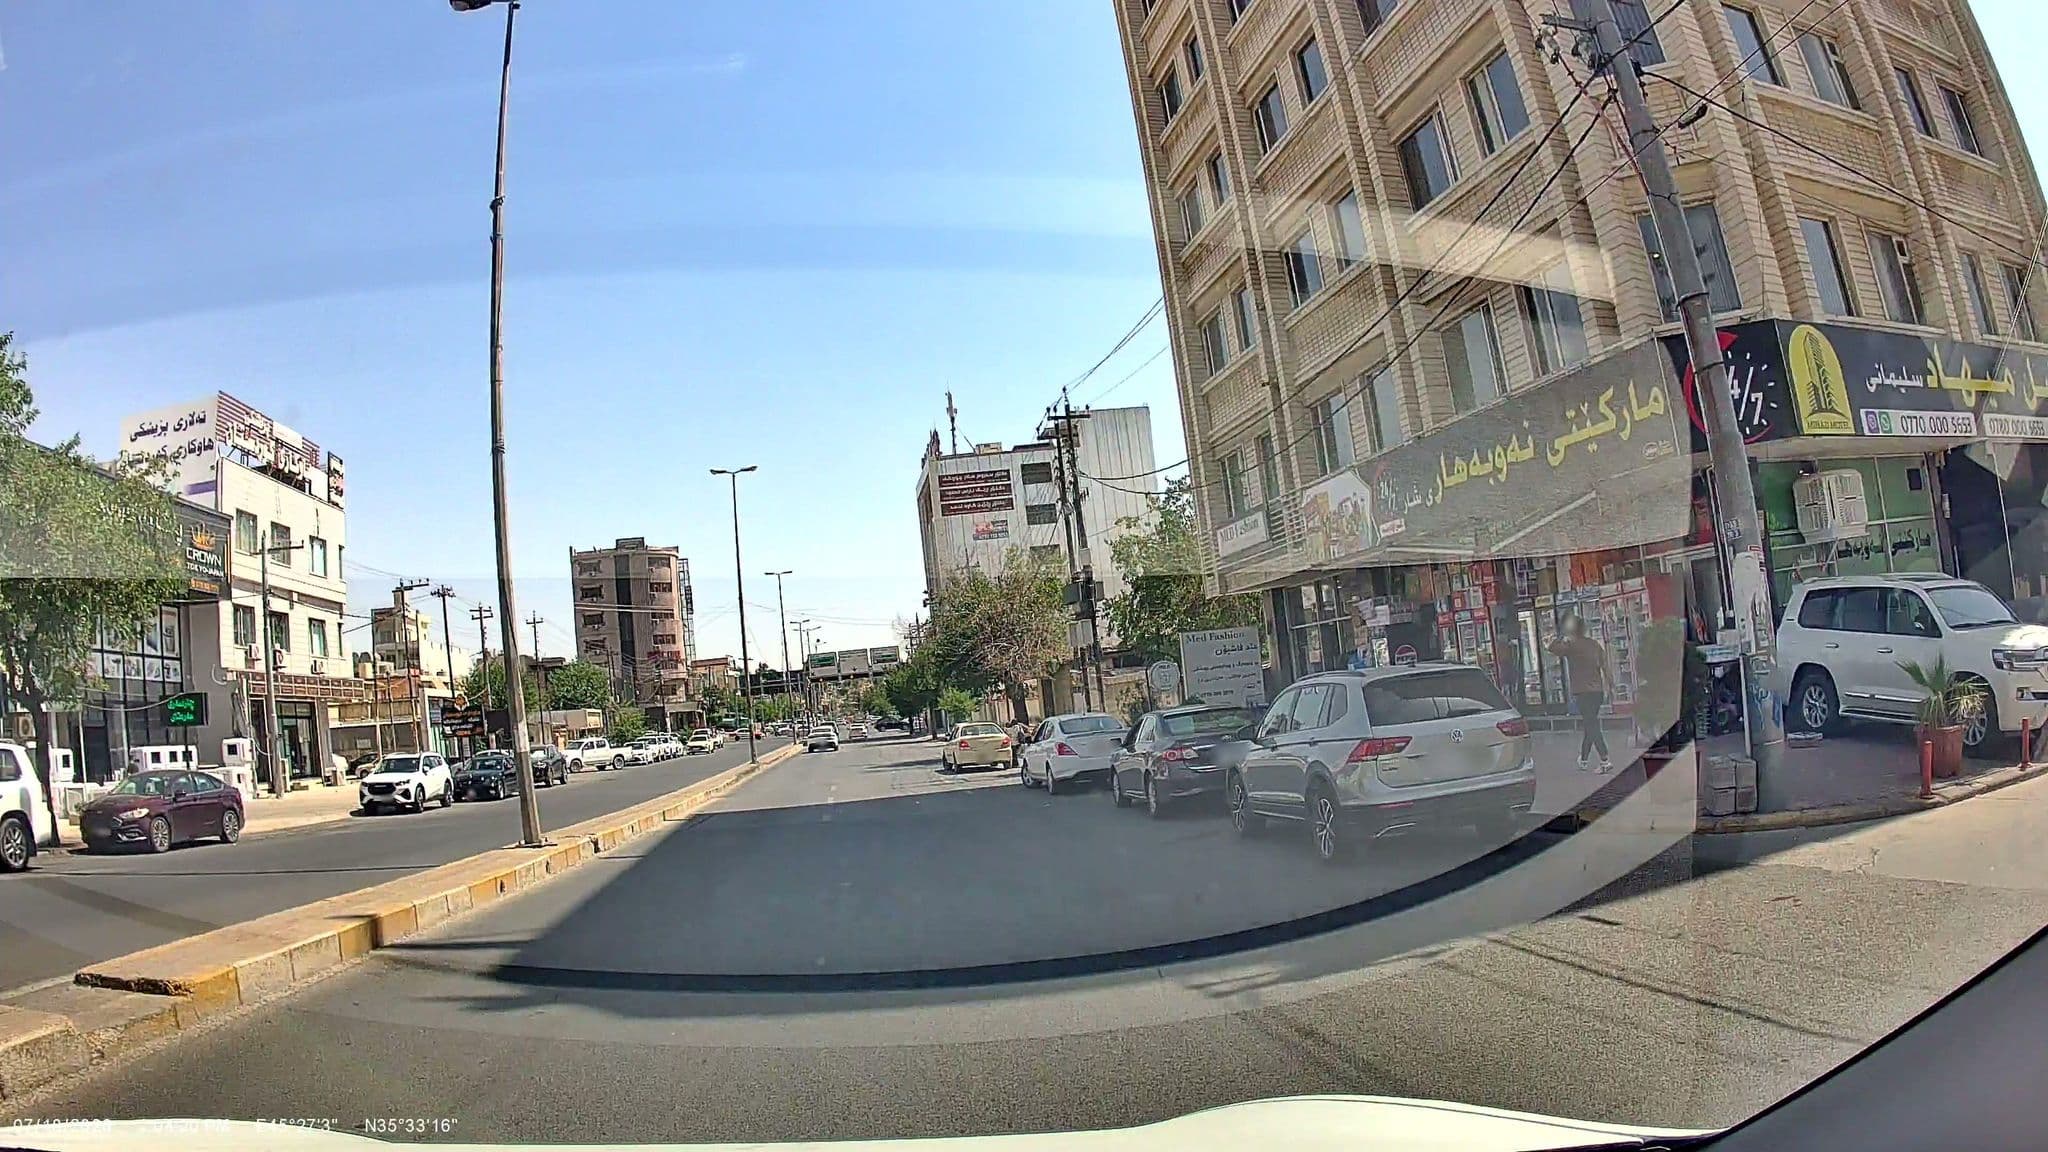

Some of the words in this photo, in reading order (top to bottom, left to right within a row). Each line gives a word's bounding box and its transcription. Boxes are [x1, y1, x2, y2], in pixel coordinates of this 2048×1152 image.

[1900, 415, 1927, 434] 0770
[1929, 416, 1949, 434] 000
[186, 546, 222, 567] CROWN
[1186, 632, 1206, 644] Med
[1209, 630, 1244, 641] Fashion
